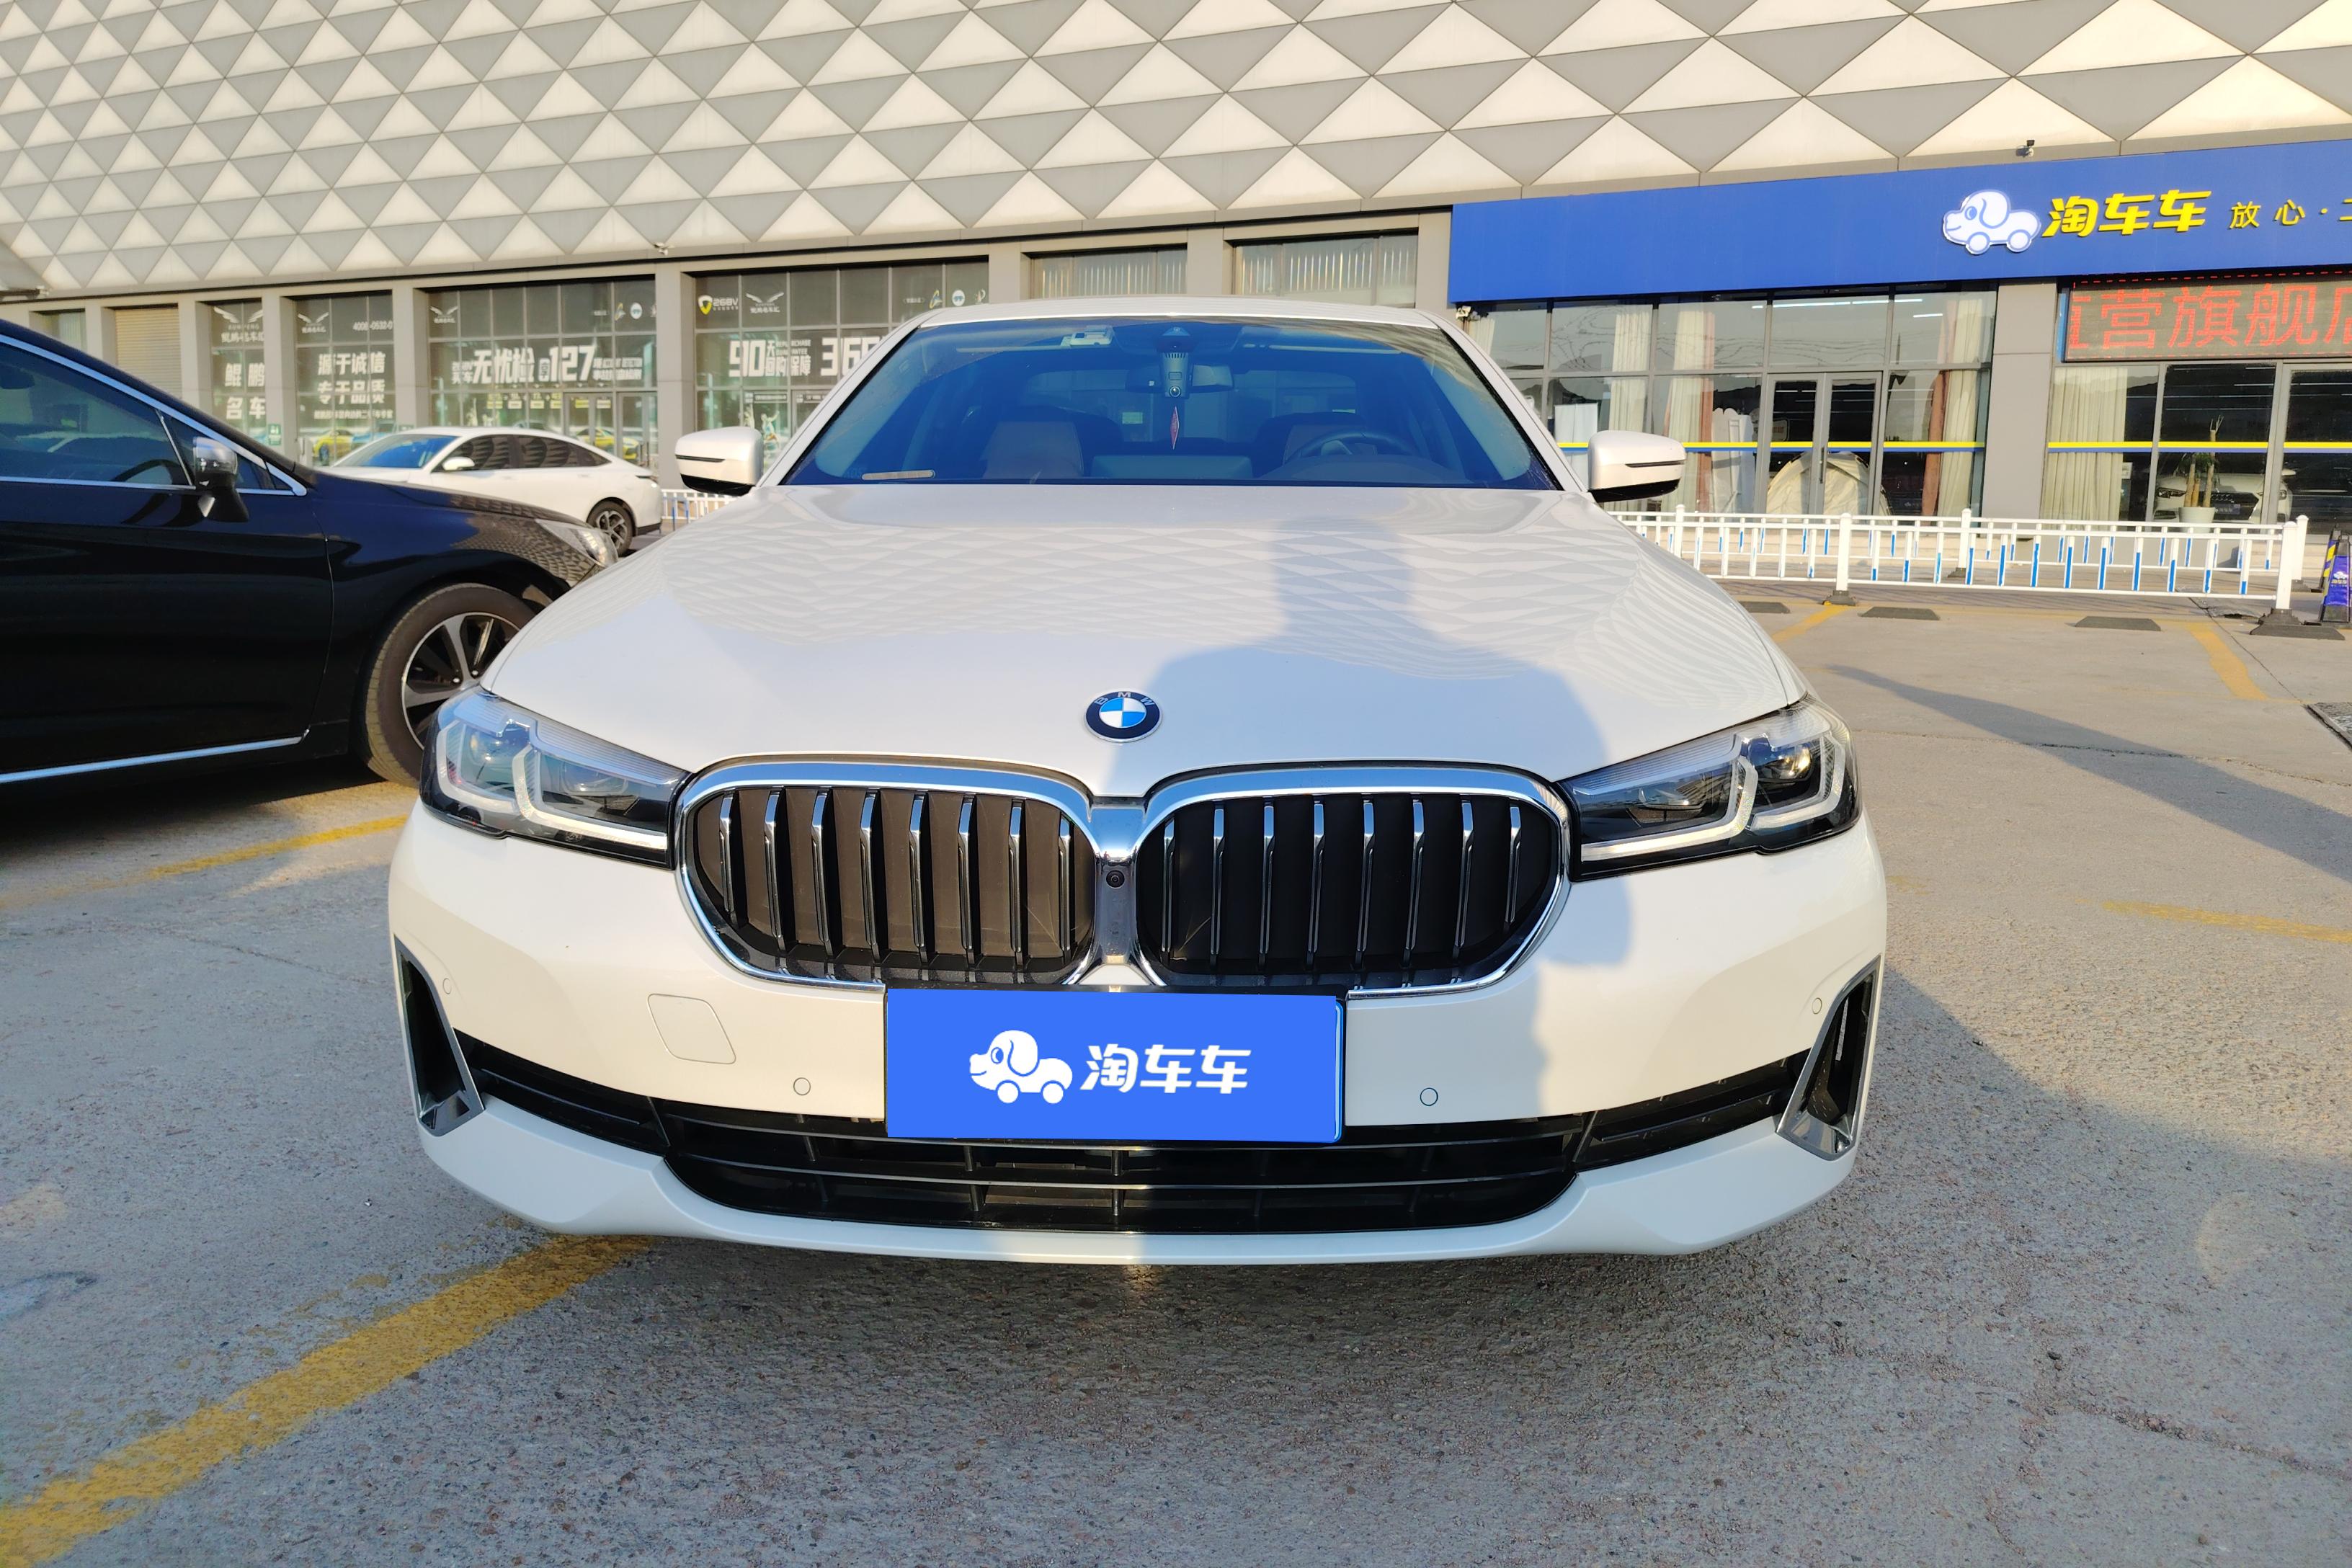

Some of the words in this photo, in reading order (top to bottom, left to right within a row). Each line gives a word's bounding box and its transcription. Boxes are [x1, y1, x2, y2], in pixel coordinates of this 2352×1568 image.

[2041, 190, 2211, 237] 淘车车
[1094, 692, 1155, 705] BMW
